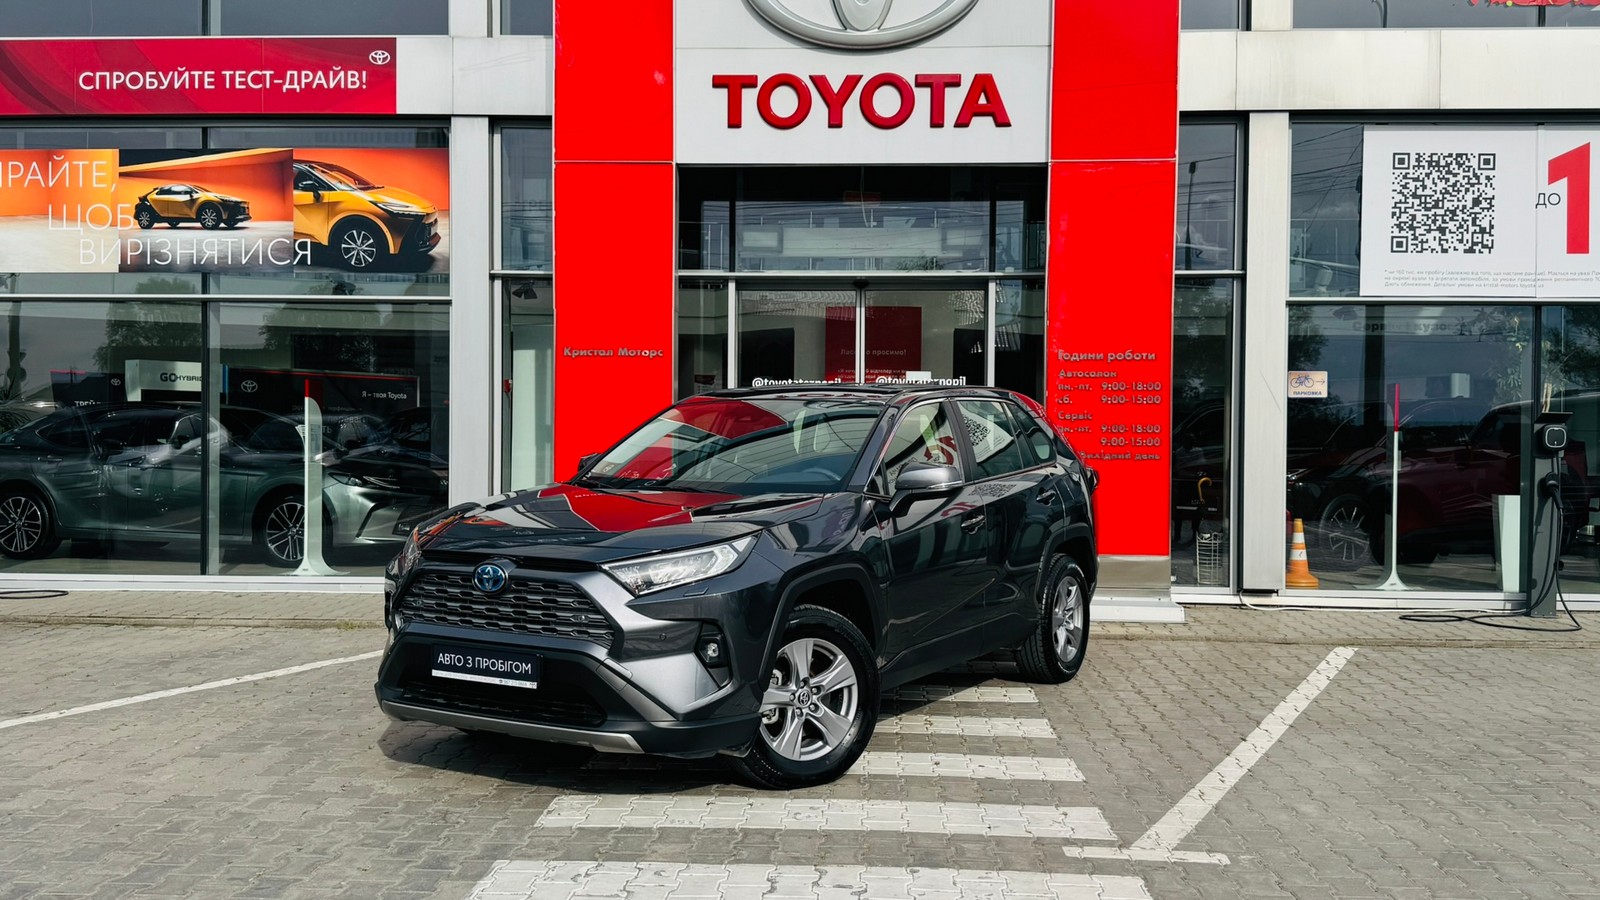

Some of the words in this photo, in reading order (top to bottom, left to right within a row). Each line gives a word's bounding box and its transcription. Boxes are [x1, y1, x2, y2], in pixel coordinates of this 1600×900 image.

[78, 66, 215, 91] СПРОБУЙТЕ
[221, 65, 367, 92] ТЕСТ-ДРАЙВ!
[712, 72, 1011, 129] TOYOTA
[0, 155, 117, 191] РАЙТЕ,
[1535, 192, 1561, 209] ДО
[48, 203, 135, 235] ЩОБ
[79, 237, 312, 266] ВИРІЗНЯТИСЯ
[563, 347, 614, 359] Кристал
[617, 347, 664, 359] Моторс
[1057, 349, 1104, 361] Години
[1107, 349, 1156, 362] роботи
[1058, 369, 1117, 378] Автосалон
[1057, 383, 1093, 391] пн.-пт.
[1101, 381, 1162, 391] 9:00-18:00
[387, 391, 408, 401] Toyota
[1057, 394, 1073, 404] сб.
[1101, 394, 1162, 404] 9:00-15:00
[1057, 410, 1093, 422] Сервіс
[1101, 424, 1161, 434] 9:00-18:00
[1100, 437, 1161, 446] 9:00-15:00
[1134, 452, 1161, 461] день
[437, 652, 464, 666] АВТО
[466, 656, 473, 668] З
[475, 657, 532, 675] ПРОБІГОМ
